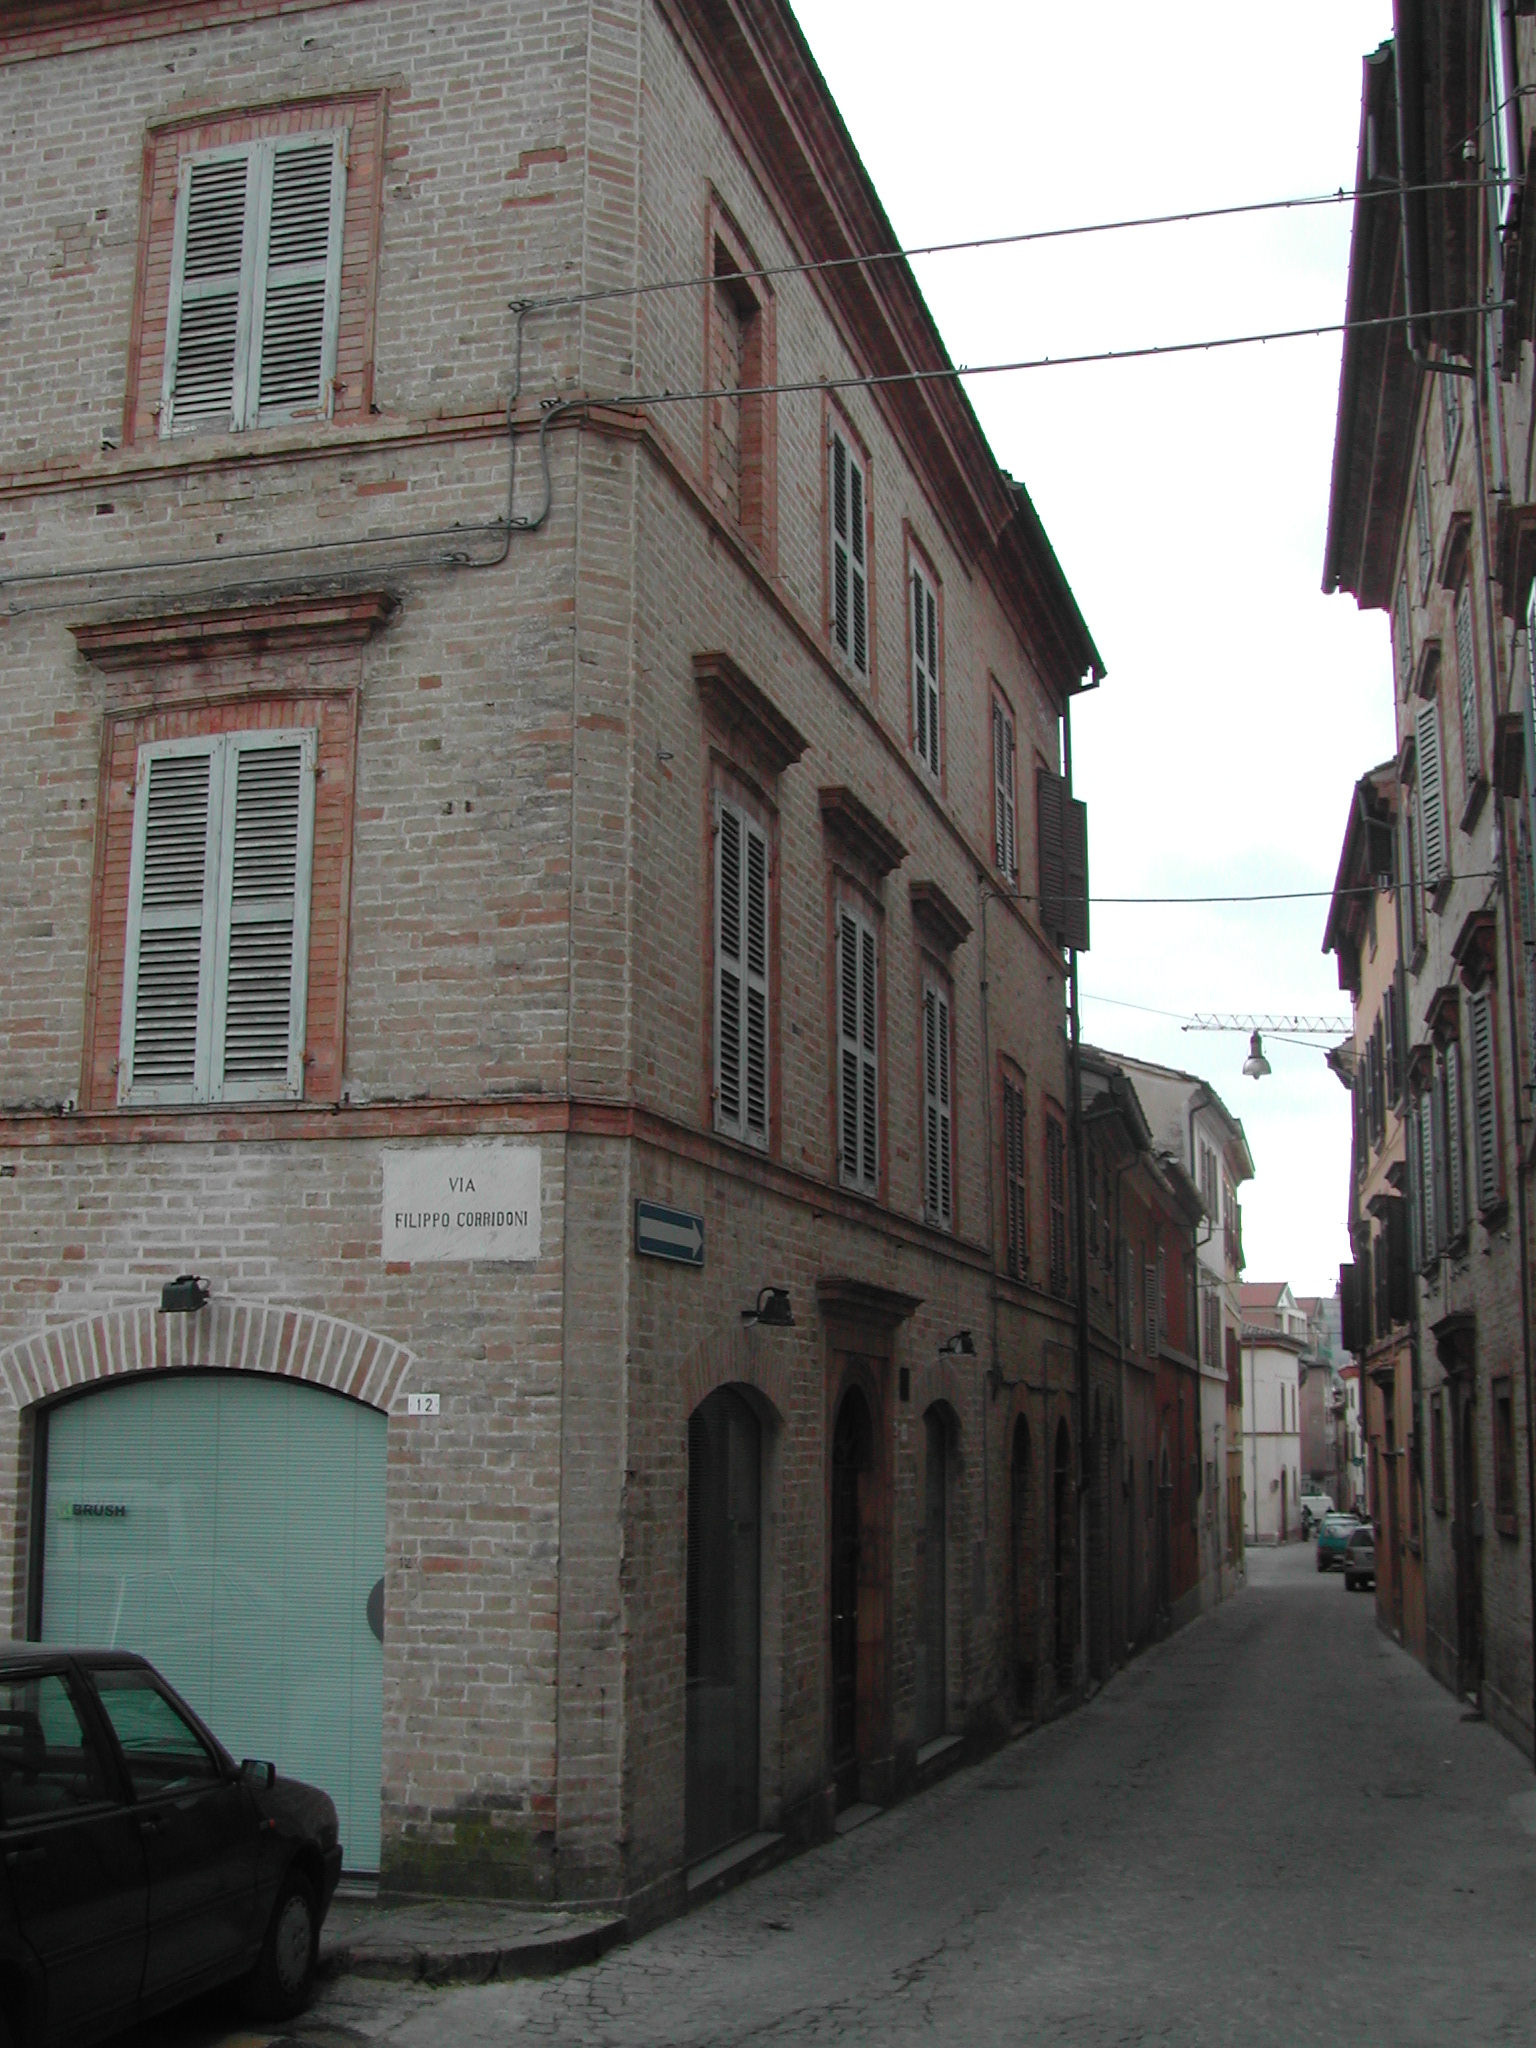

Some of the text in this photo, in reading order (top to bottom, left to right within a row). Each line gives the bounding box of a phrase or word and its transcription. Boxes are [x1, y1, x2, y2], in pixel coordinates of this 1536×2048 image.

[448, 1177, 476, 1193] VIA
[395, 1210, 528, 1228] FILIPPO CORRIDONI
[417, 1397, 433, 1412] 12
